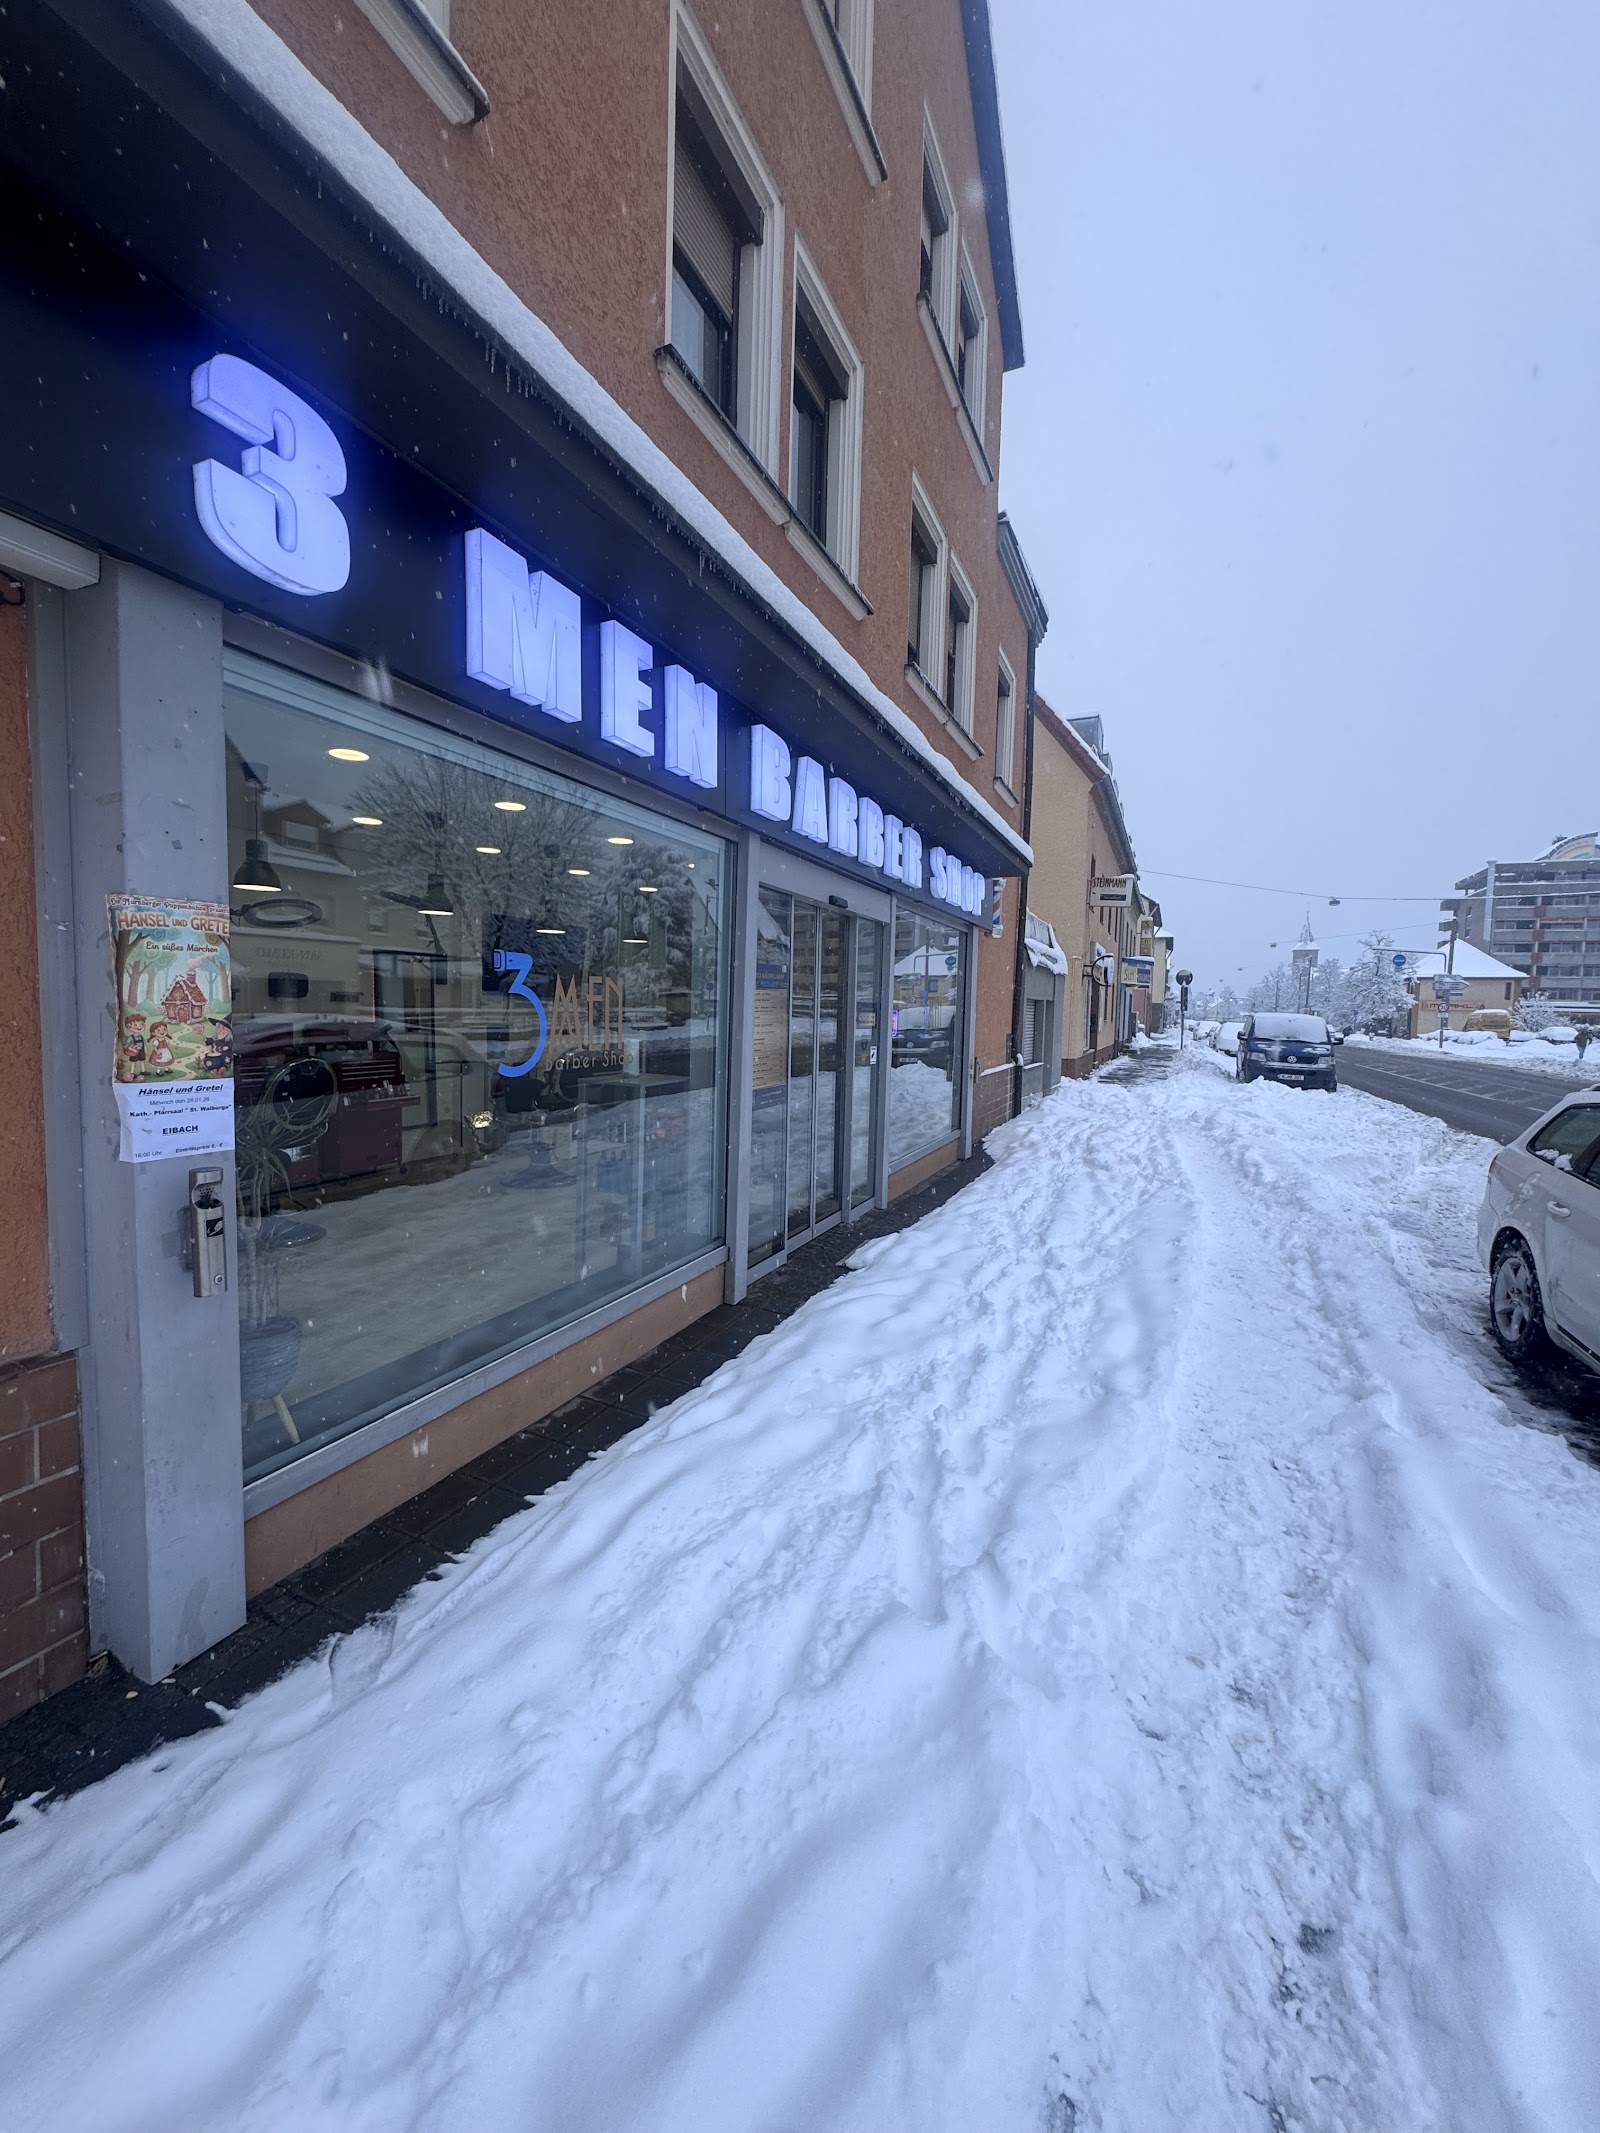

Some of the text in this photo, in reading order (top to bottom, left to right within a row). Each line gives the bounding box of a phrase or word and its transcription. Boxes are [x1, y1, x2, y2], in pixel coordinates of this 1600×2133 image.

[191, 353, 986, 916] 3 MEN BARBER SHOP
[117, 909, 170, 929] HÄNSEL
[172, 918, 188, 927] UND
[145, 941, 218, 953] Ein süßes Märchen
[493, 949, 624, 1078] 3 MEN
[545, 1051, 633, 1072] Barber Shop
[138, 1086, 173, 1095] Hänsel
[195, 1084, 223, 1092] Gretel
[162, 1125, 199, 1135] EIBACH
